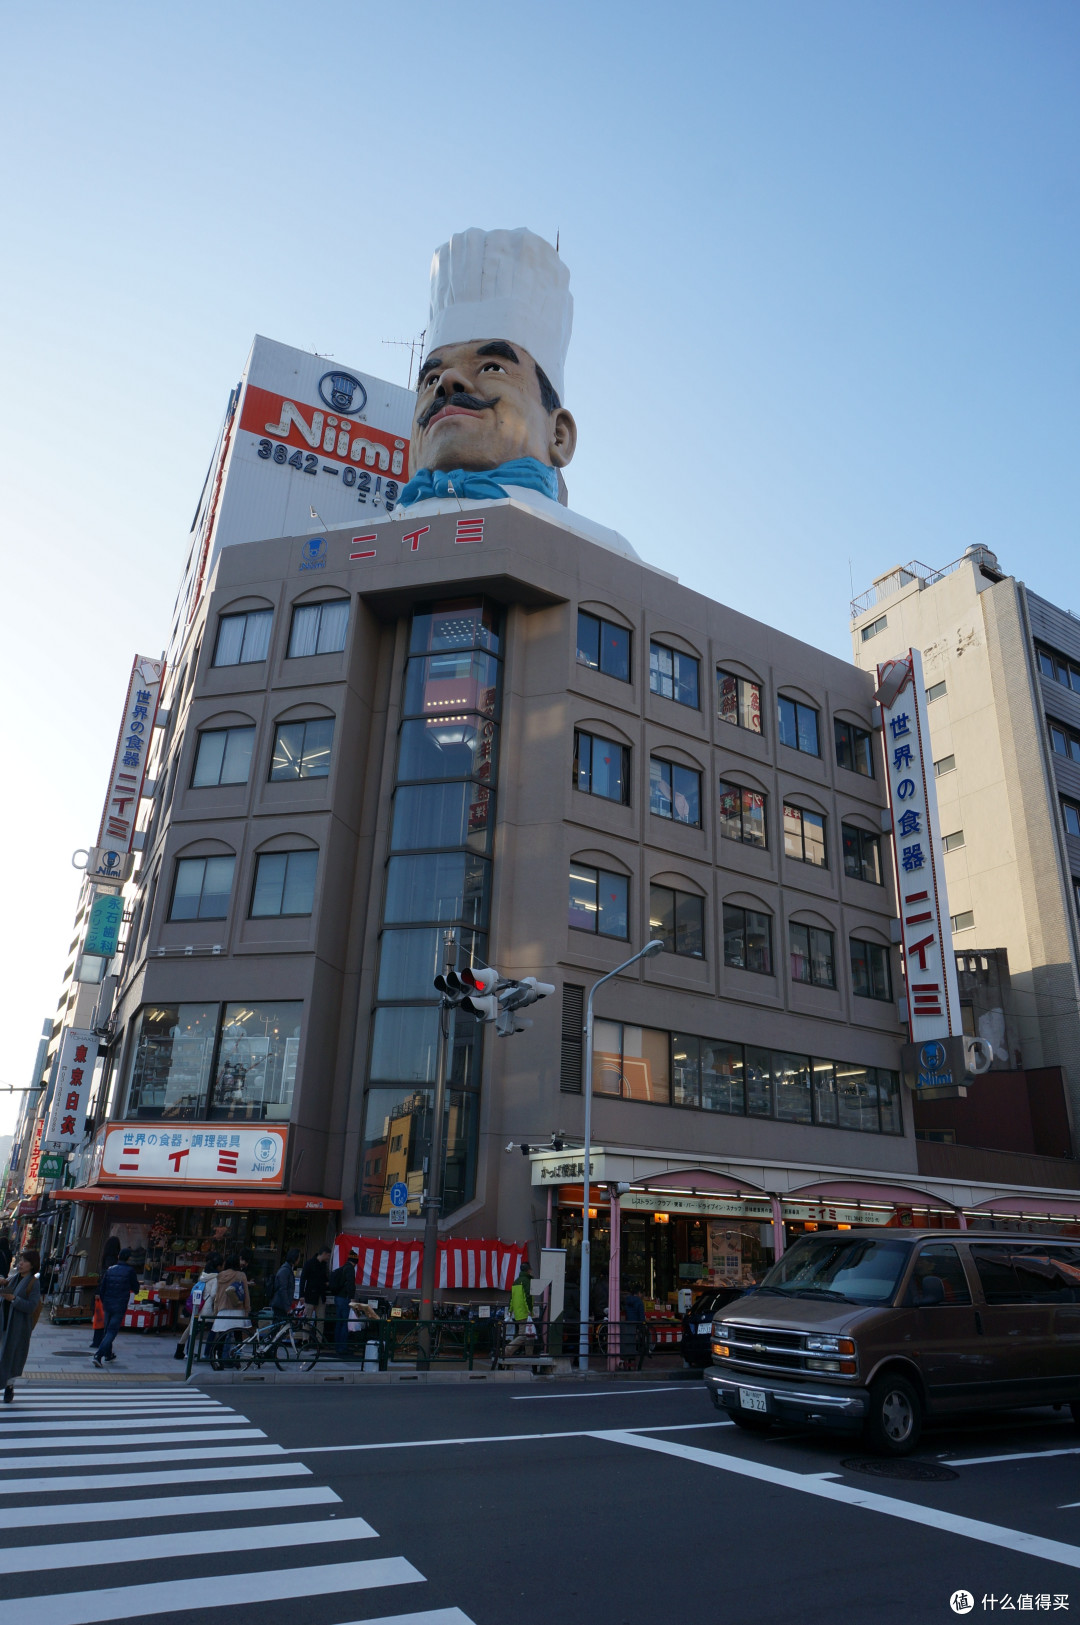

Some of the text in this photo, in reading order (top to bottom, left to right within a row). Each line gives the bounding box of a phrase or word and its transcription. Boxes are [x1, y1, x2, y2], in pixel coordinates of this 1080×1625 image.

[264, 400, 406, 476] Niimi
[256, 438, 399, 500] 3842-0213
[357, 492, 395, 513] ニミ
[349, 517, 486, 561] ニイミ
[122, 689, 152, 768] 世界の食器
[106, 772, 138, 841] ニイミ
[889, 712, 926, 873] 世界の食器
[96, 865, 122, 879] Niimi
[88, 909, 103, 950] クリニック
[100, 897, 121, 953] 永石歯科
[904, 889, 943, 1017] ニイミ
[60, 1044, 88, 1135] 東京白衣
[916, 1067, 953, 1088] Niimi
[119, 1148, 239, 1174] ニイミ
[123, 1132, 241, 1148] 世界の食器・調理器具
[251, 1162, 275, 1172] Niimi
[808, 1207, 837, 1220] ニイミ
